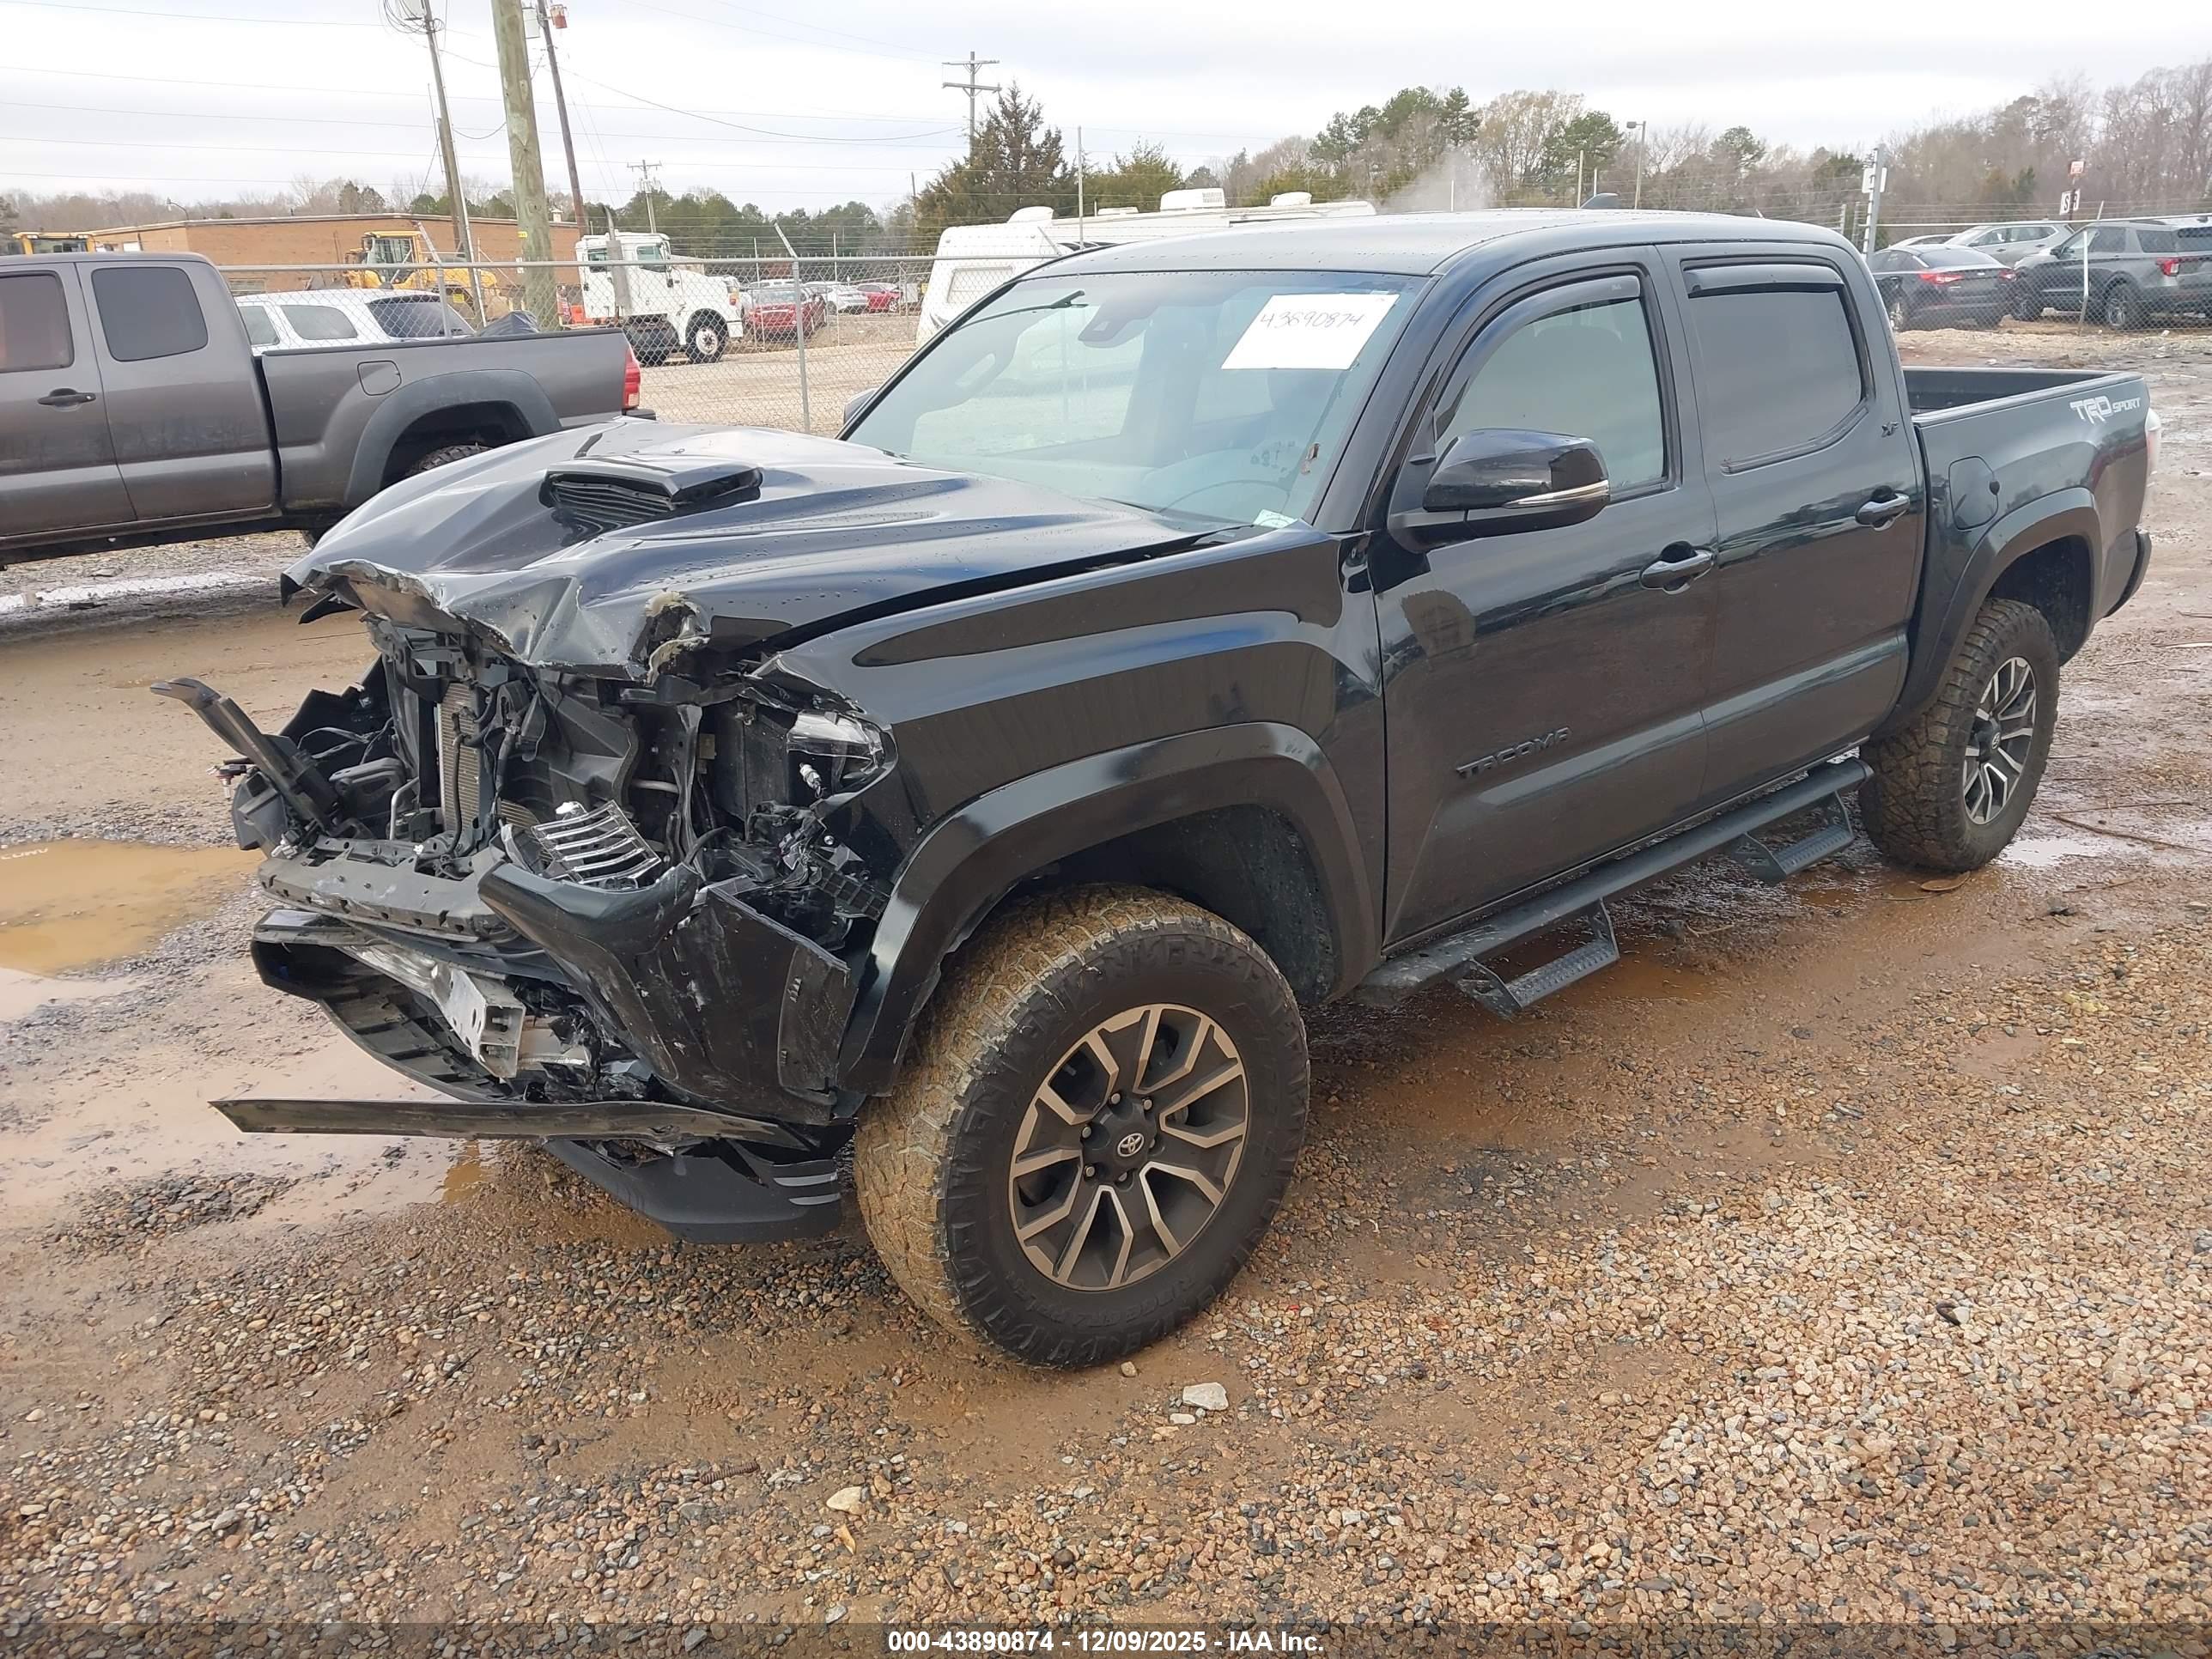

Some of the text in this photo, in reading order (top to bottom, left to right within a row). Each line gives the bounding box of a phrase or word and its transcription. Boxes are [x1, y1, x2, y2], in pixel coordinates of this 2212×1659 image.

[1260, 311, 1364, 329] 43890874
[2069, 395, 2142, 425] TRD SPORT
[1455, 726, 1572, 779] TACOMA
